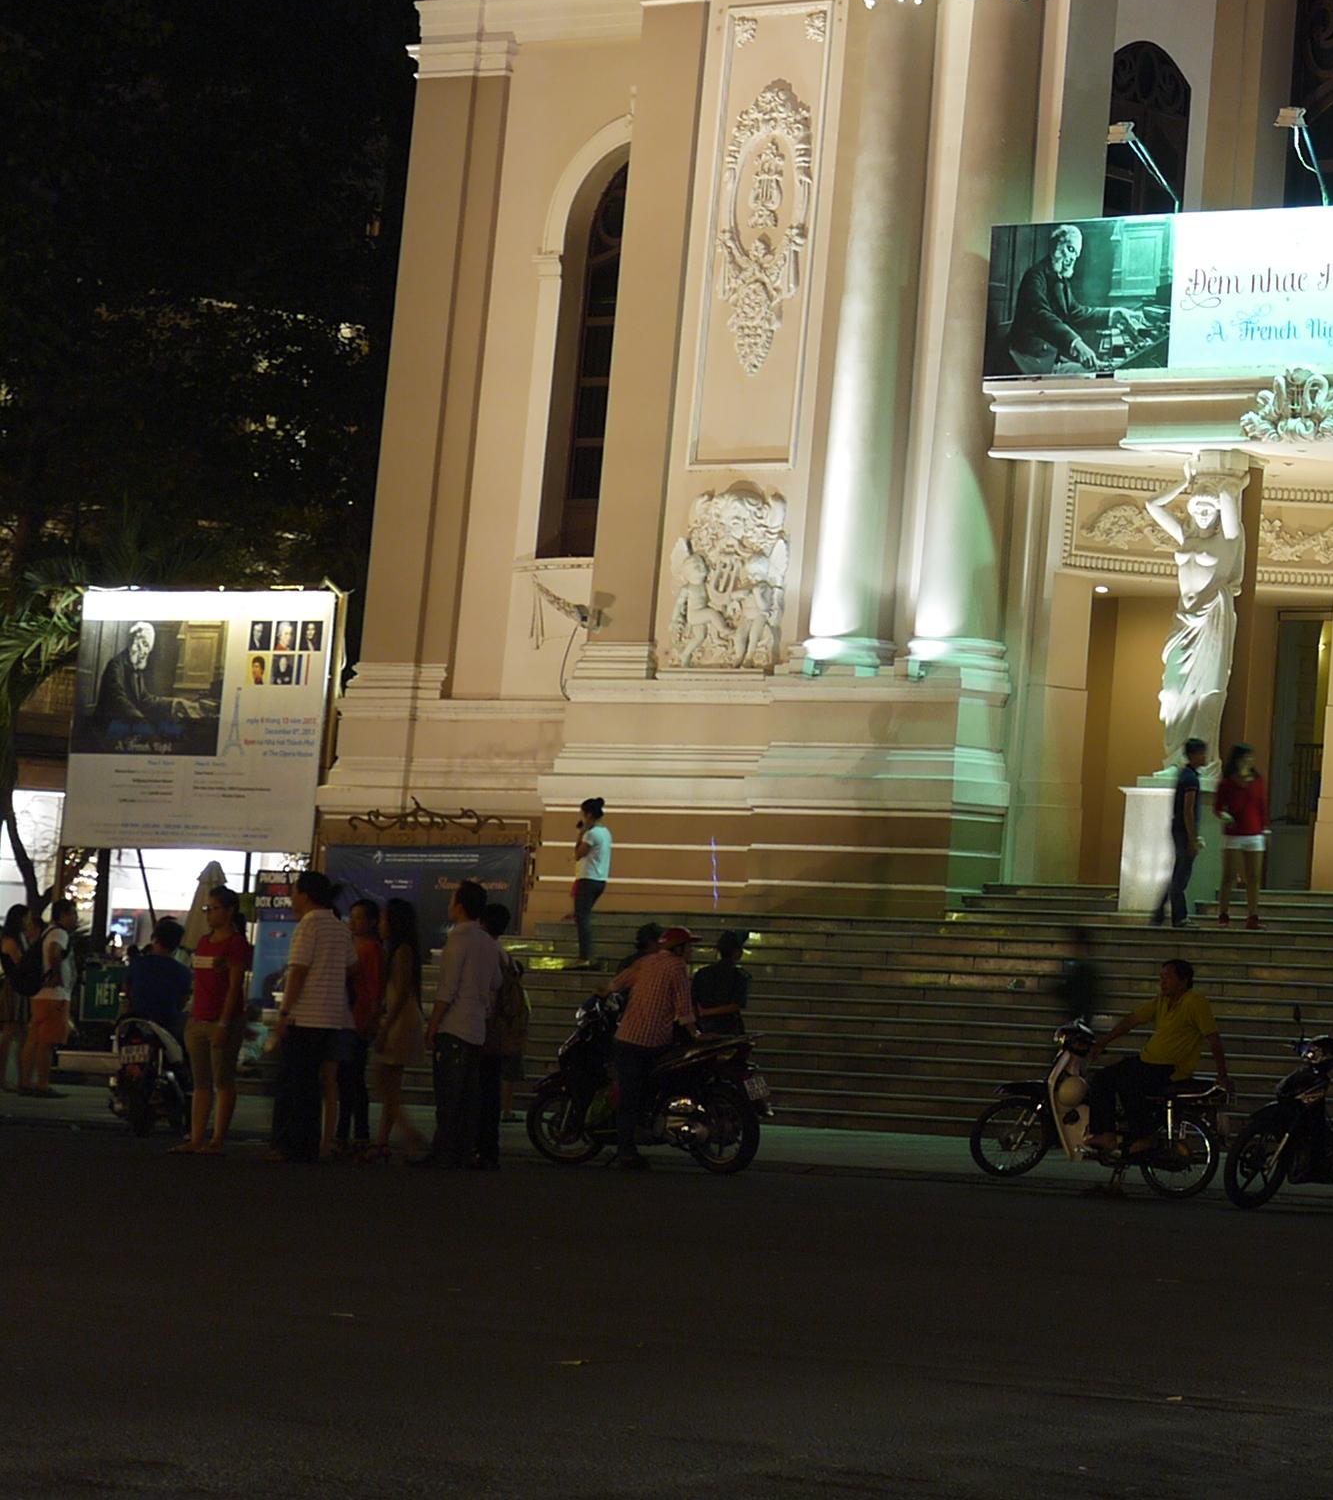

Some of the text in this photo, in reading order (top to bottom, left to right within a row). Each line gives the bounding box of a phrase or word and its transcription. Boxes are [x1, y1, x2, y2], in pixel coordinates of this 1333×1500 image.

[1180, 266, 1242, 310] Đêm
[1251, 267, 1308, 302] nhạc
[1206, 320, 1227, 342] A
[1231, 304, 1299, 340] French
